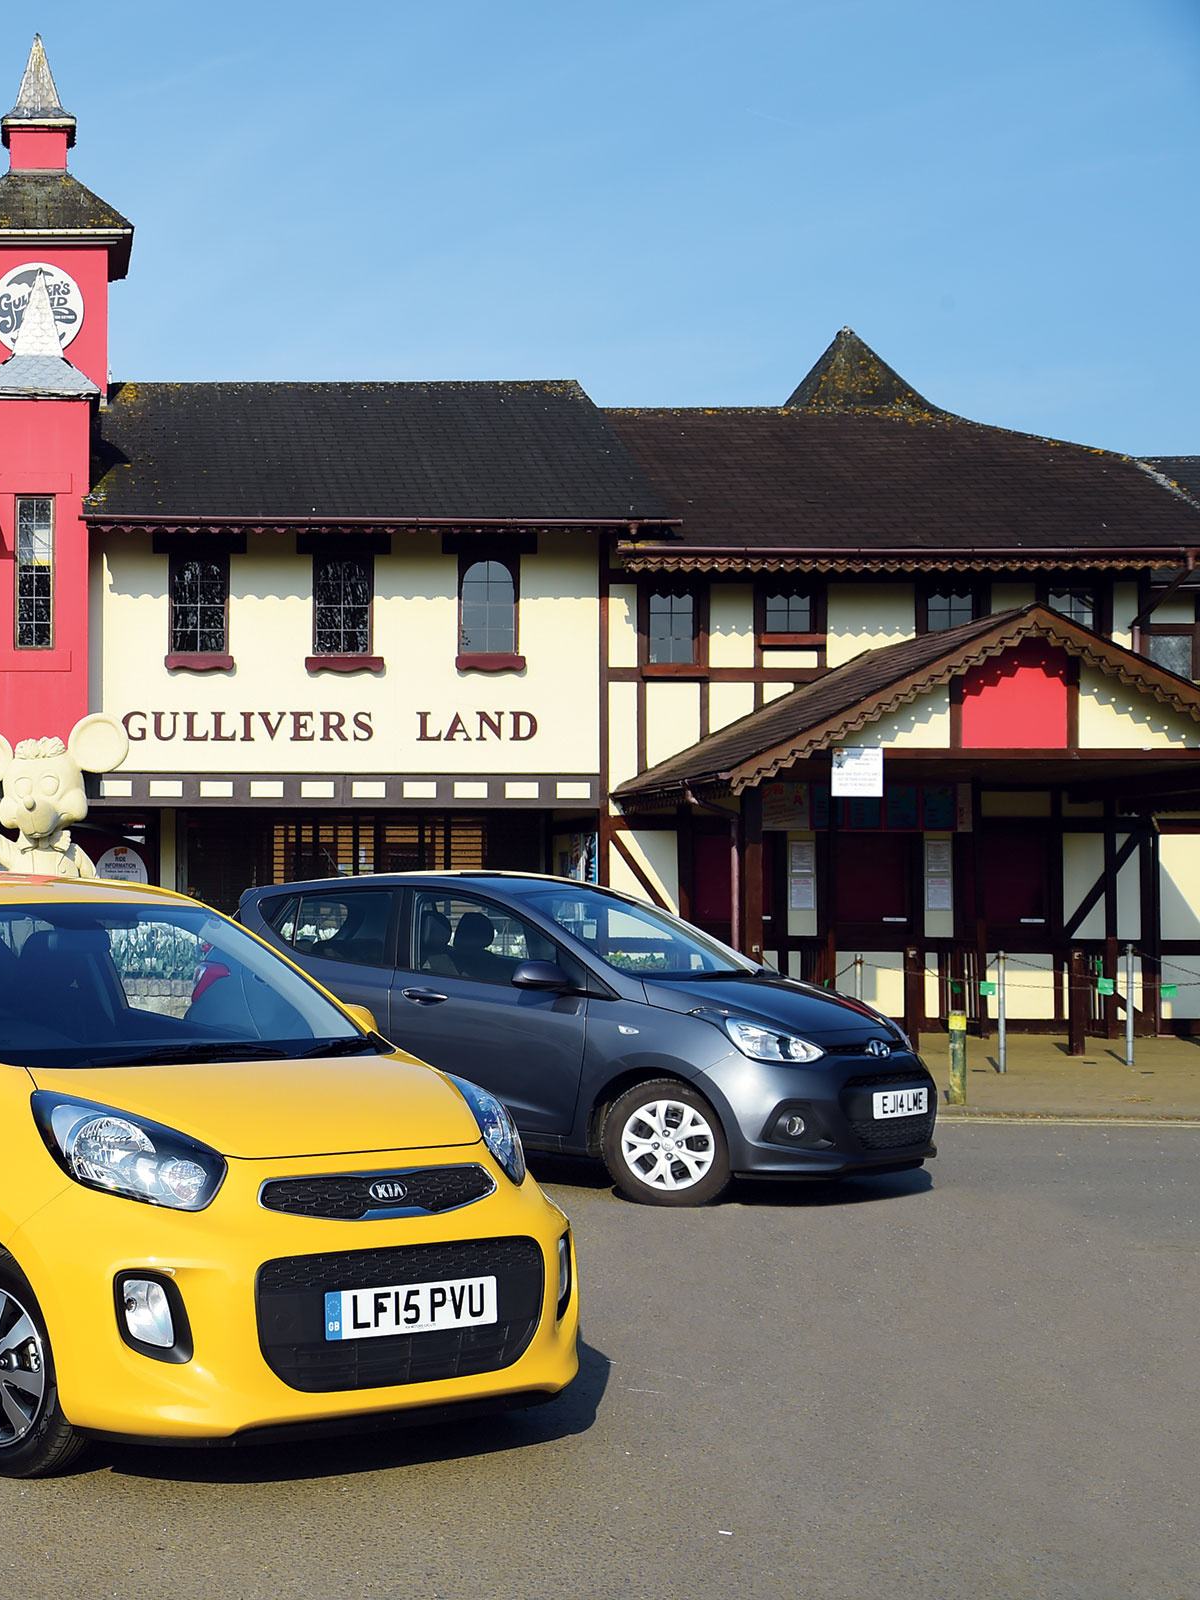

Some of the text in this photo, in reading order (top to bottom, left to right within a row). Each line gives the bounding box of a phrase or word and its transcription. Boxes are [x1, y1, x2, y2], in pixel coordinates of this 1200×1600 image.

[121, 711, 538, 741] GULLIVERS LAND
[882, 1094, 904, 1114] EJ14
[375, 1183, 404, 1198] KIA
[352, 1283, 484, 1330] LF15 PVU
[328, 1321, 340, 1331] GB
